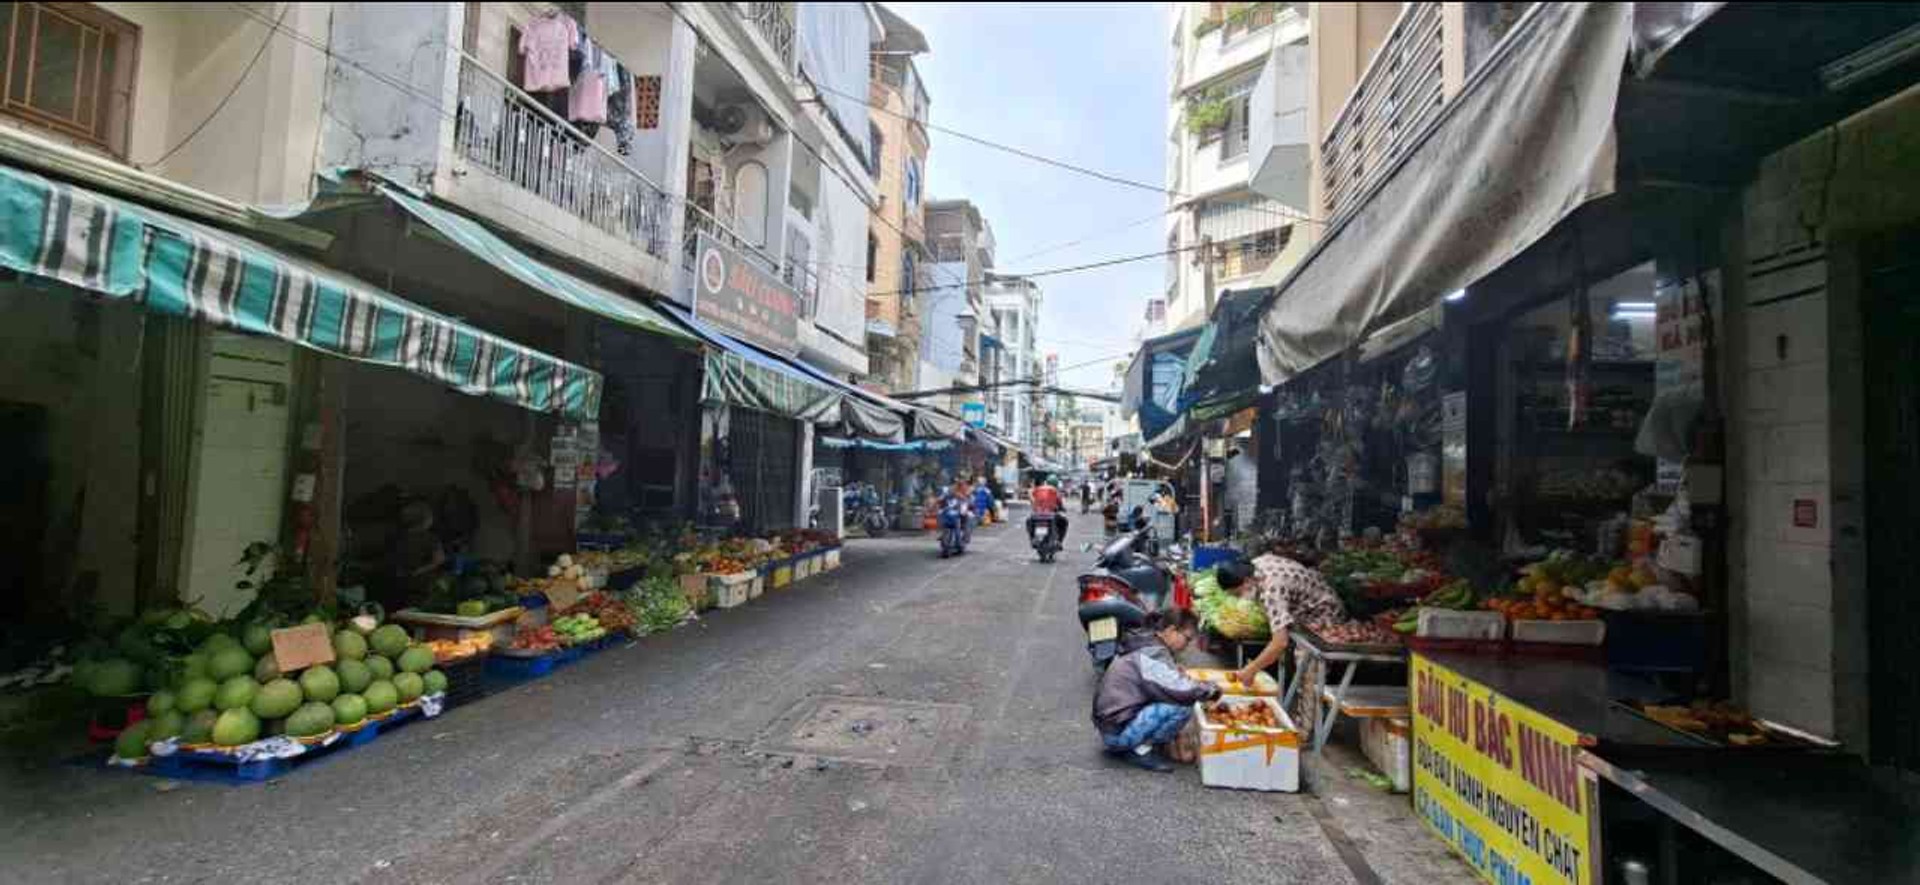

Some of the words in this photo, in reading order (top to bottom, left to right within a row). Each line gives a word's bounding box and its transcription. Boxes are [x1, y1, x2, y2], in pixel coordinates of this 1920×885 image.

[1474, 691, 1513, 769] BẮC
[1518, 721, 1581, 815] NINH
[1487, 787, 1540, 854] NGUYÊN
